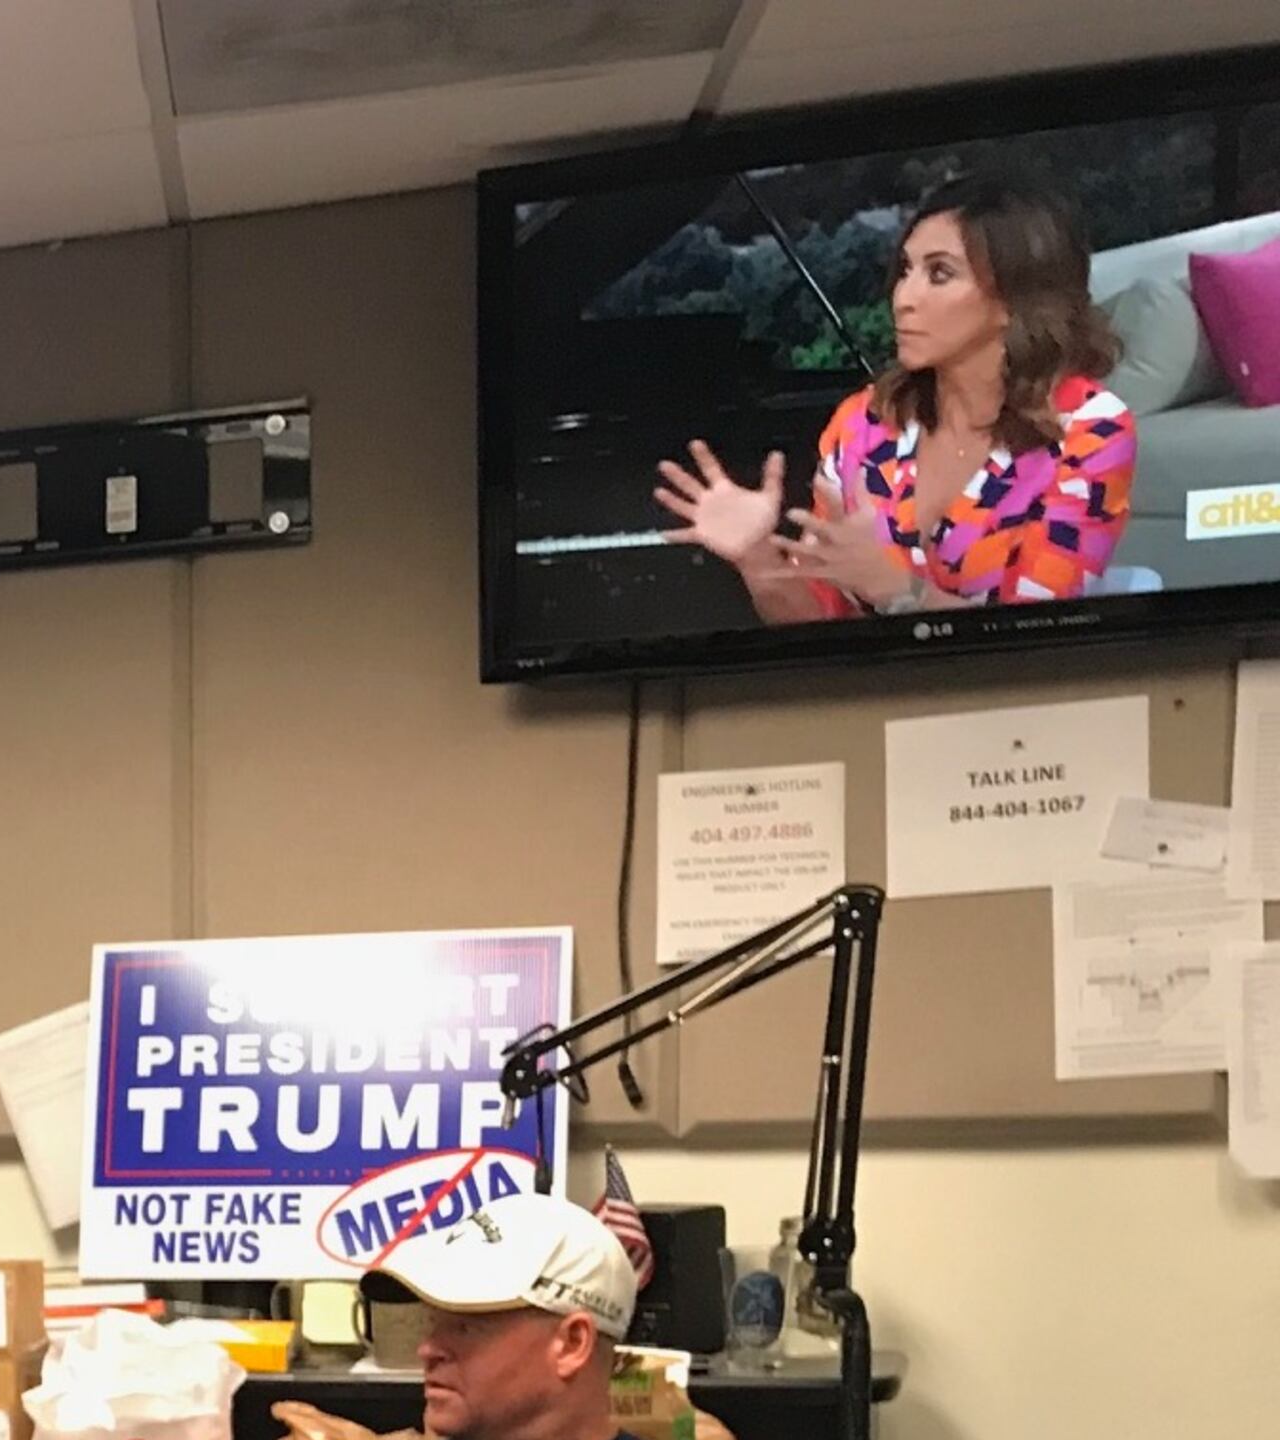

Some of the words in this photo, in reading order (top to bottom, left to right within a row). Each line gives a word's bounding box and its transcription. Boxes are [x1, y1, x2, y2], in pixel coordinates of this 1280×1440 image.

[932, 622, 954, 637] LG
[967, 769, 1017, 788] TALK
[1022, 764, 1066, 784] LINE
[949, 794, 1086, 823] 844-404-1067
[140, 984, 156, 1026] I
[136, 1027, 519, 1078] PRESIDENT
[127, 1081, 523, 1153] TRUMP
[115, 1194, 189, 1226] NOT
[204, 1192, 302, 1226] FAKE
[335, 1160, 522, 1257] MEDIA
[153, 1231, 260, 1264] NEWS
